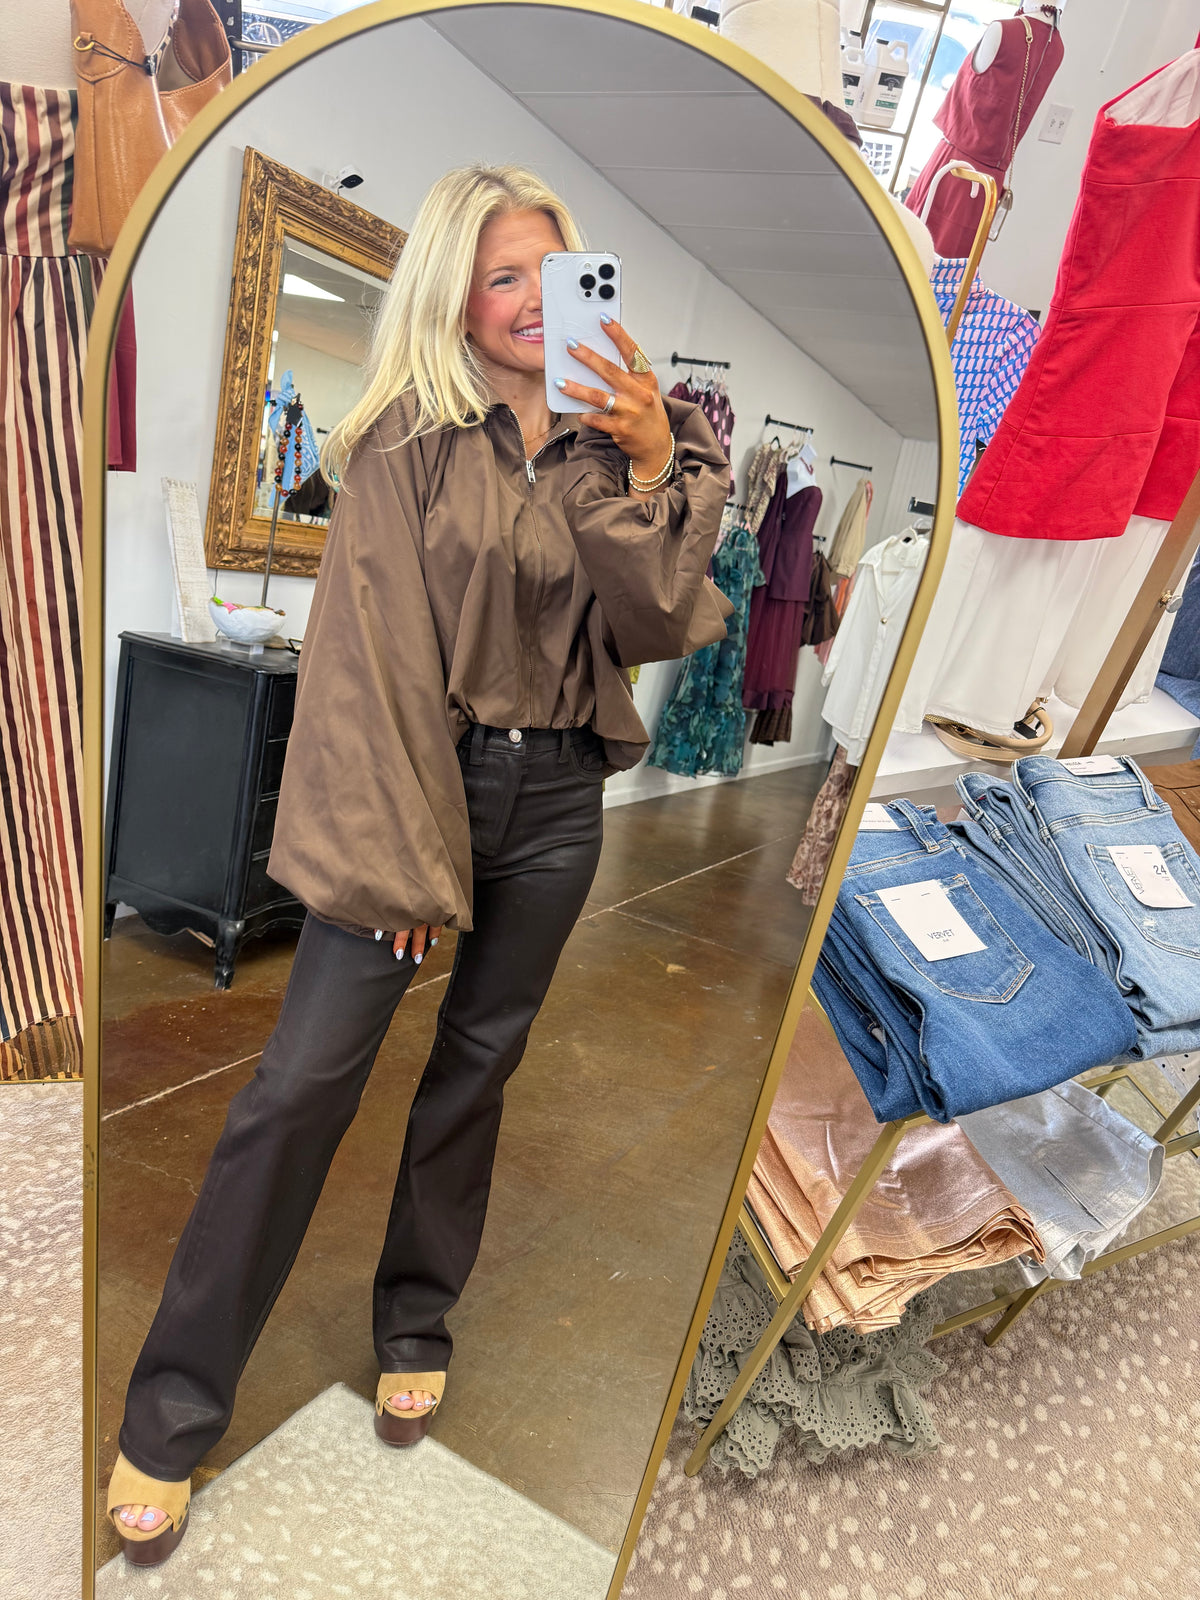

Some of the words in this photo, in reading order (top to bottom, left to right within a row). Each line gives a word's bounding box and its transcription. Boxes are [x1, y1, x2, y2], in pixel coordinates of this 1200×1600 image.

[1153, 864, 1167, 875] 24
[1120, 863, 1145, 895] VERVET
[926, 929, 955, 939] VERVET
